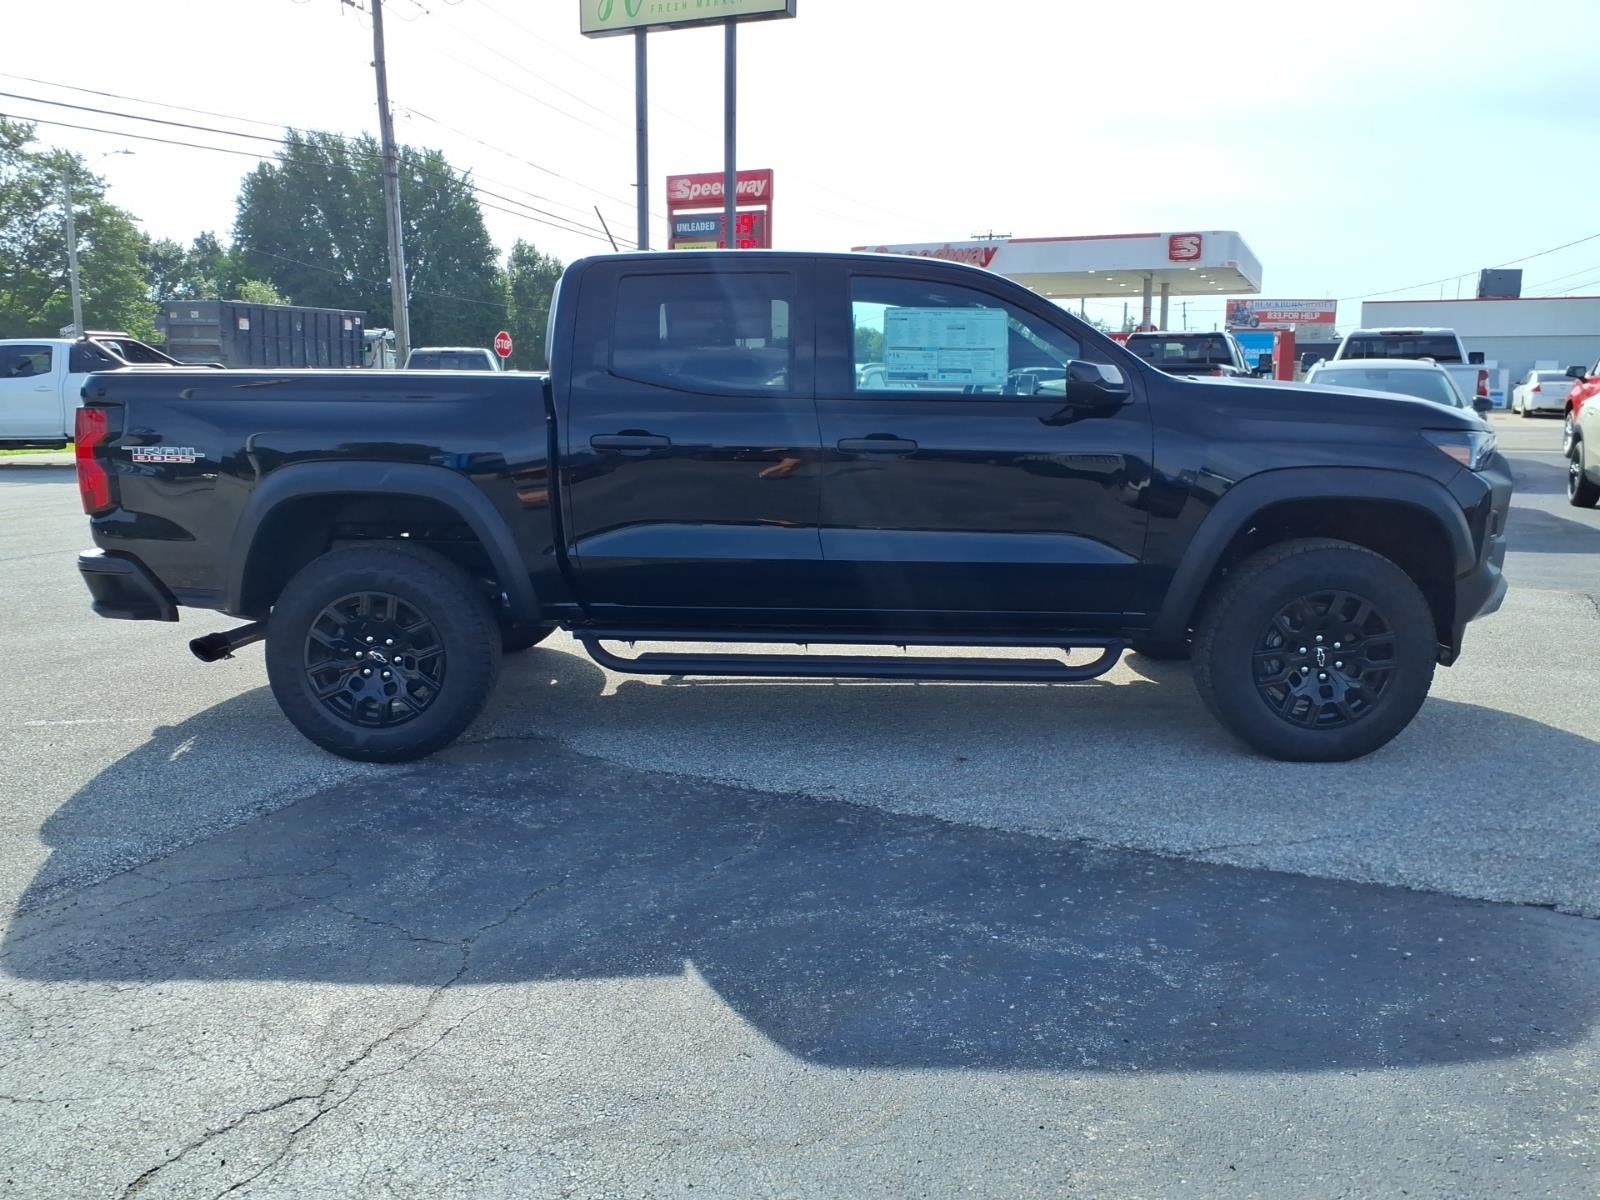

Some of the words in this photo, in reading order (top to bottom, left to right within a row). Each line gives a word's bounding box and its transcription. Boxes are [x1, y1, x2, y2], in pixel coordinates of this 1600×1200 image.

[650, 3, 687, 13] FRESH
[672, 179, 767, 200] Speeway
[676, 221, 716, 232] UNLEADED
[874, 243, 999, 268] dway
[1300, 312, 1320, 320] HELP
[496, 338, 512, 350] STOP
[121, 445, 206, 457] TRAIL
[132, 454, 196, 464] BOSS
